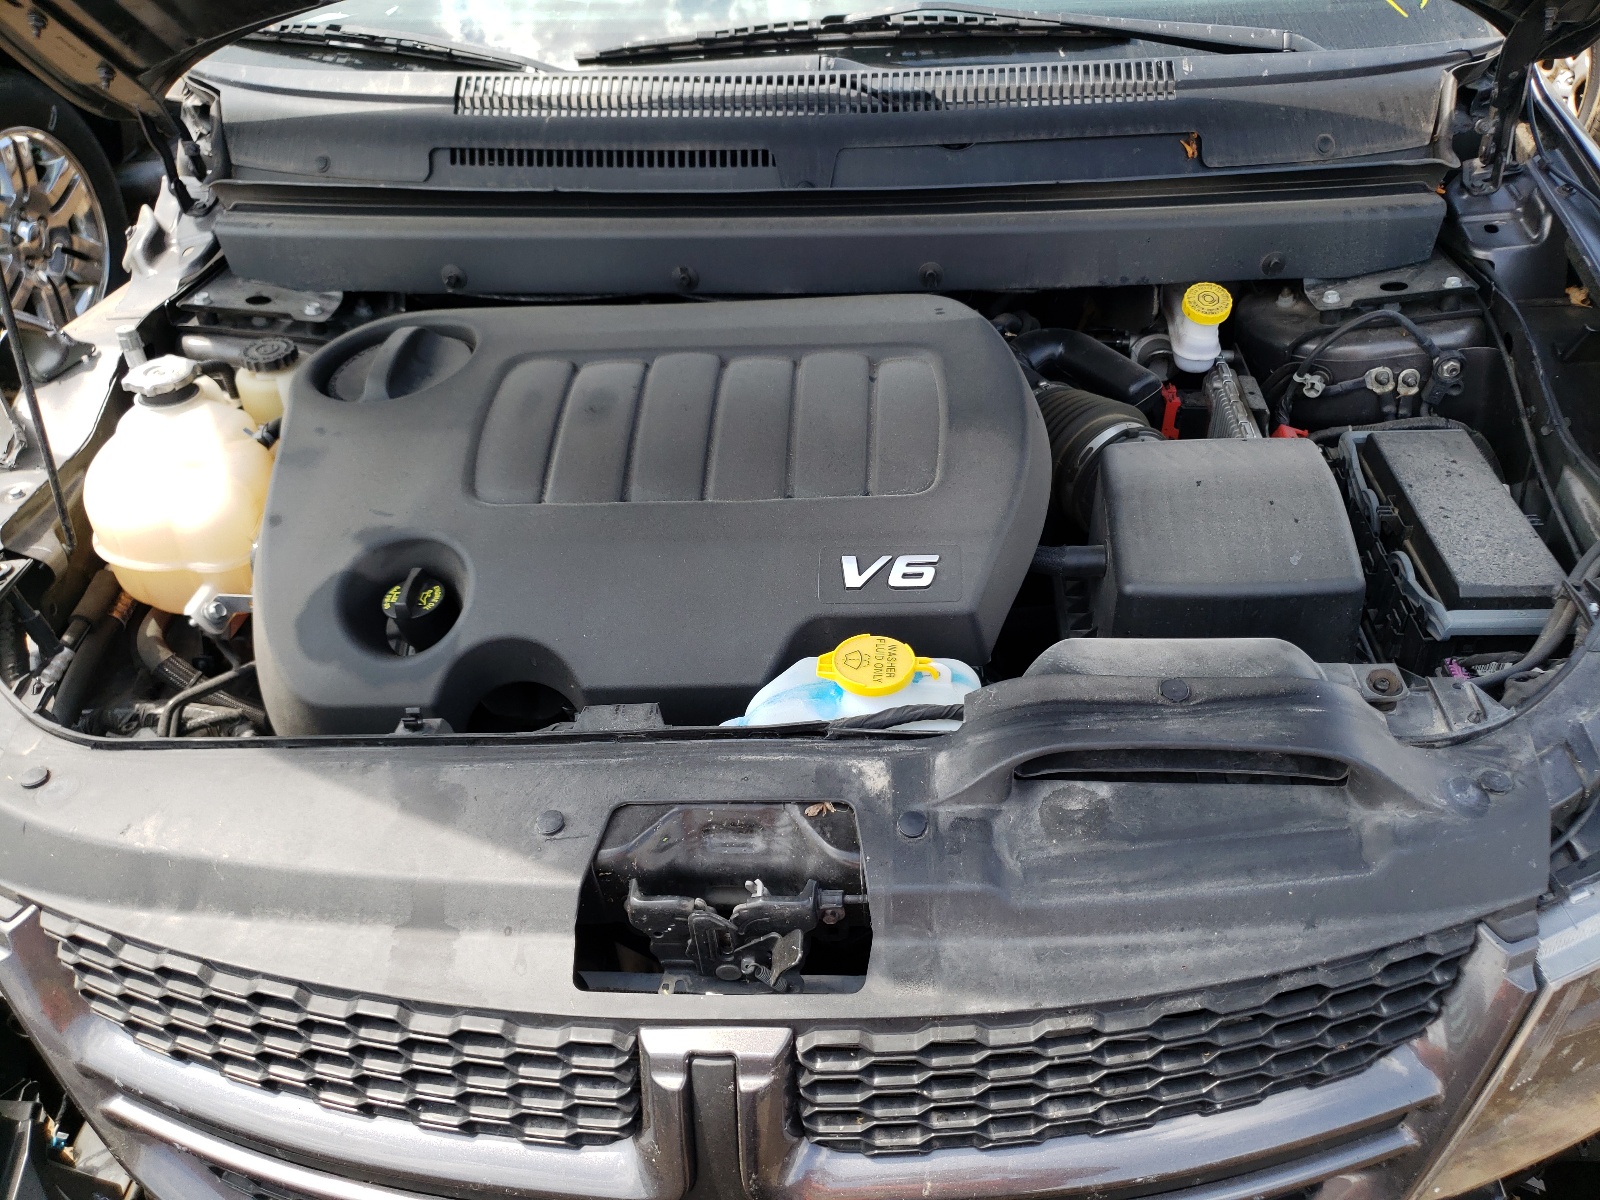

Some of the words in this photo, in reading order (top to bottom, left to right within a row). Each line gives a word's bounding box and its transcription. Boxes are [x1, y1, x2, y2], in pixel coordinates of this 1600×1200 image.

[841, 554, 939, 591] V6
[874, 638, 886, 661] FLUID
[886, 644, 897, 678] WASHER
[873, 663, 883, 683] ONLY
